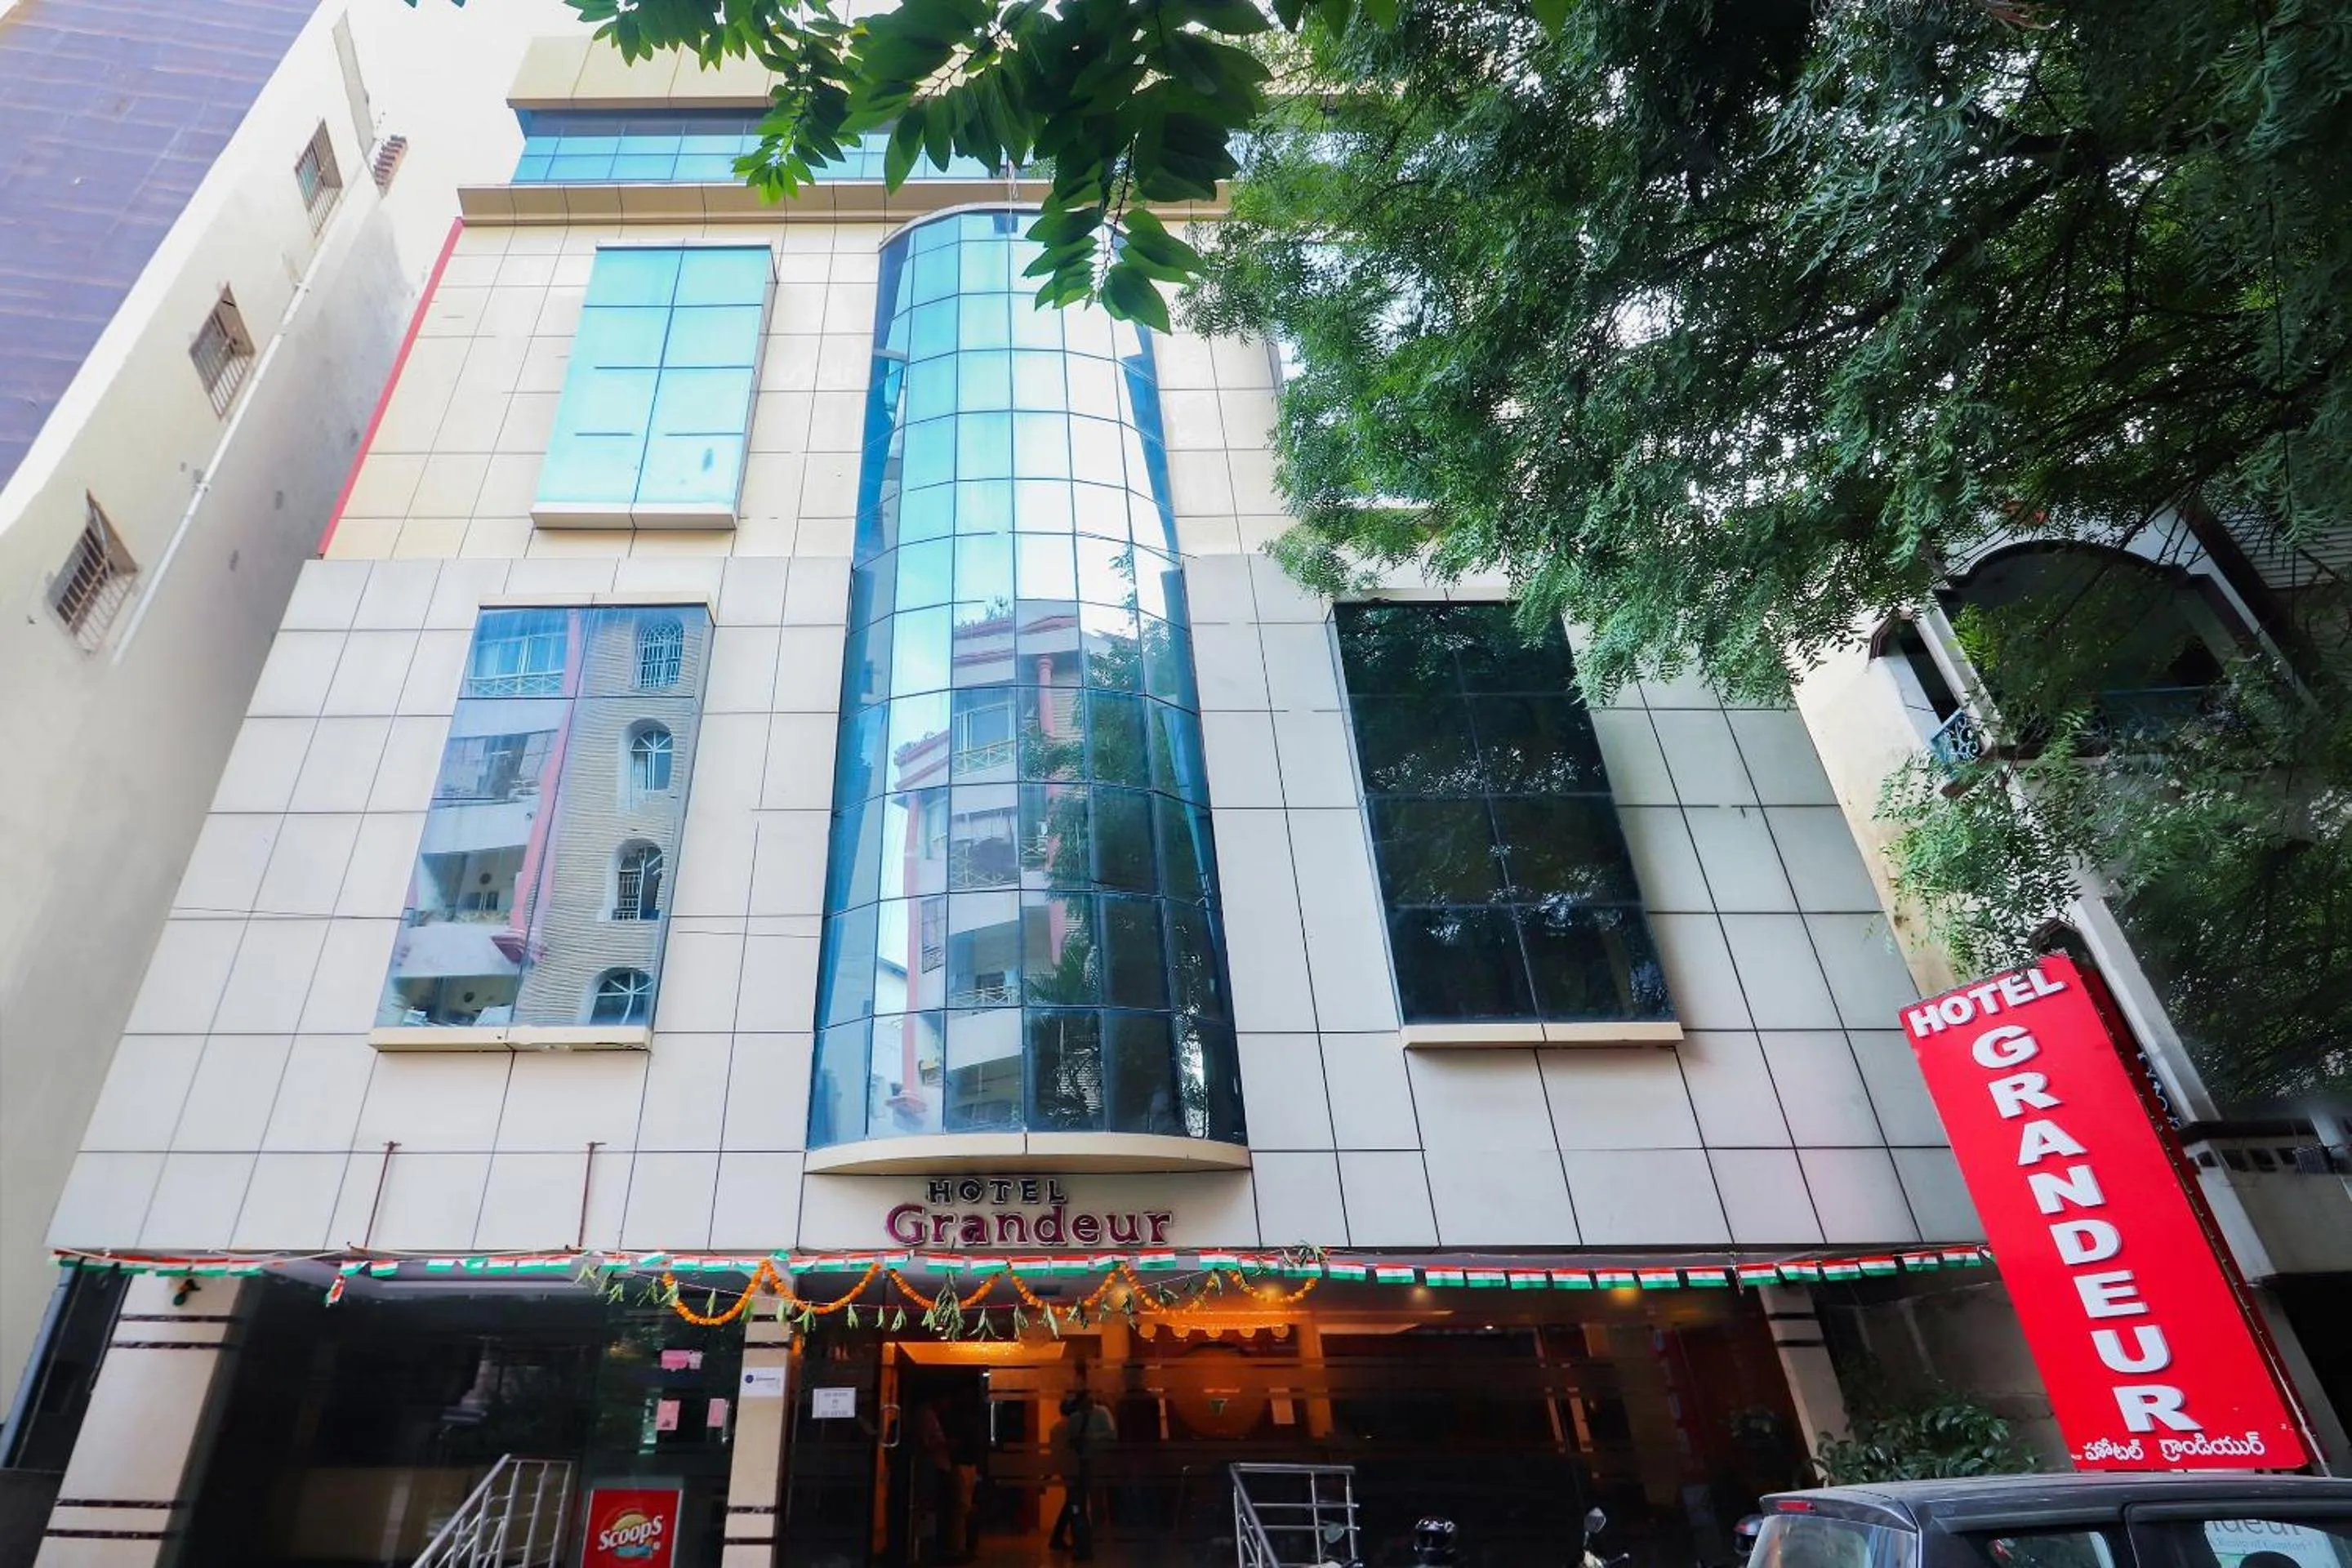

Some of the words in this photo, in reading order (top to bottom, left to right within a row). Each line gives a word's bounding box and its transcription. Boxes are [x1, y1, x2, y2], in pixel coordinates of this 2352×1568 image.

[1908, 969, 2067, 1038] HOTEL
[928, 1178, 1068, 1204] HOTEL
[886, 1203, 1173, 1247] Grandeur
[1972, 1025, 2203, 1432] GRANDEUR
